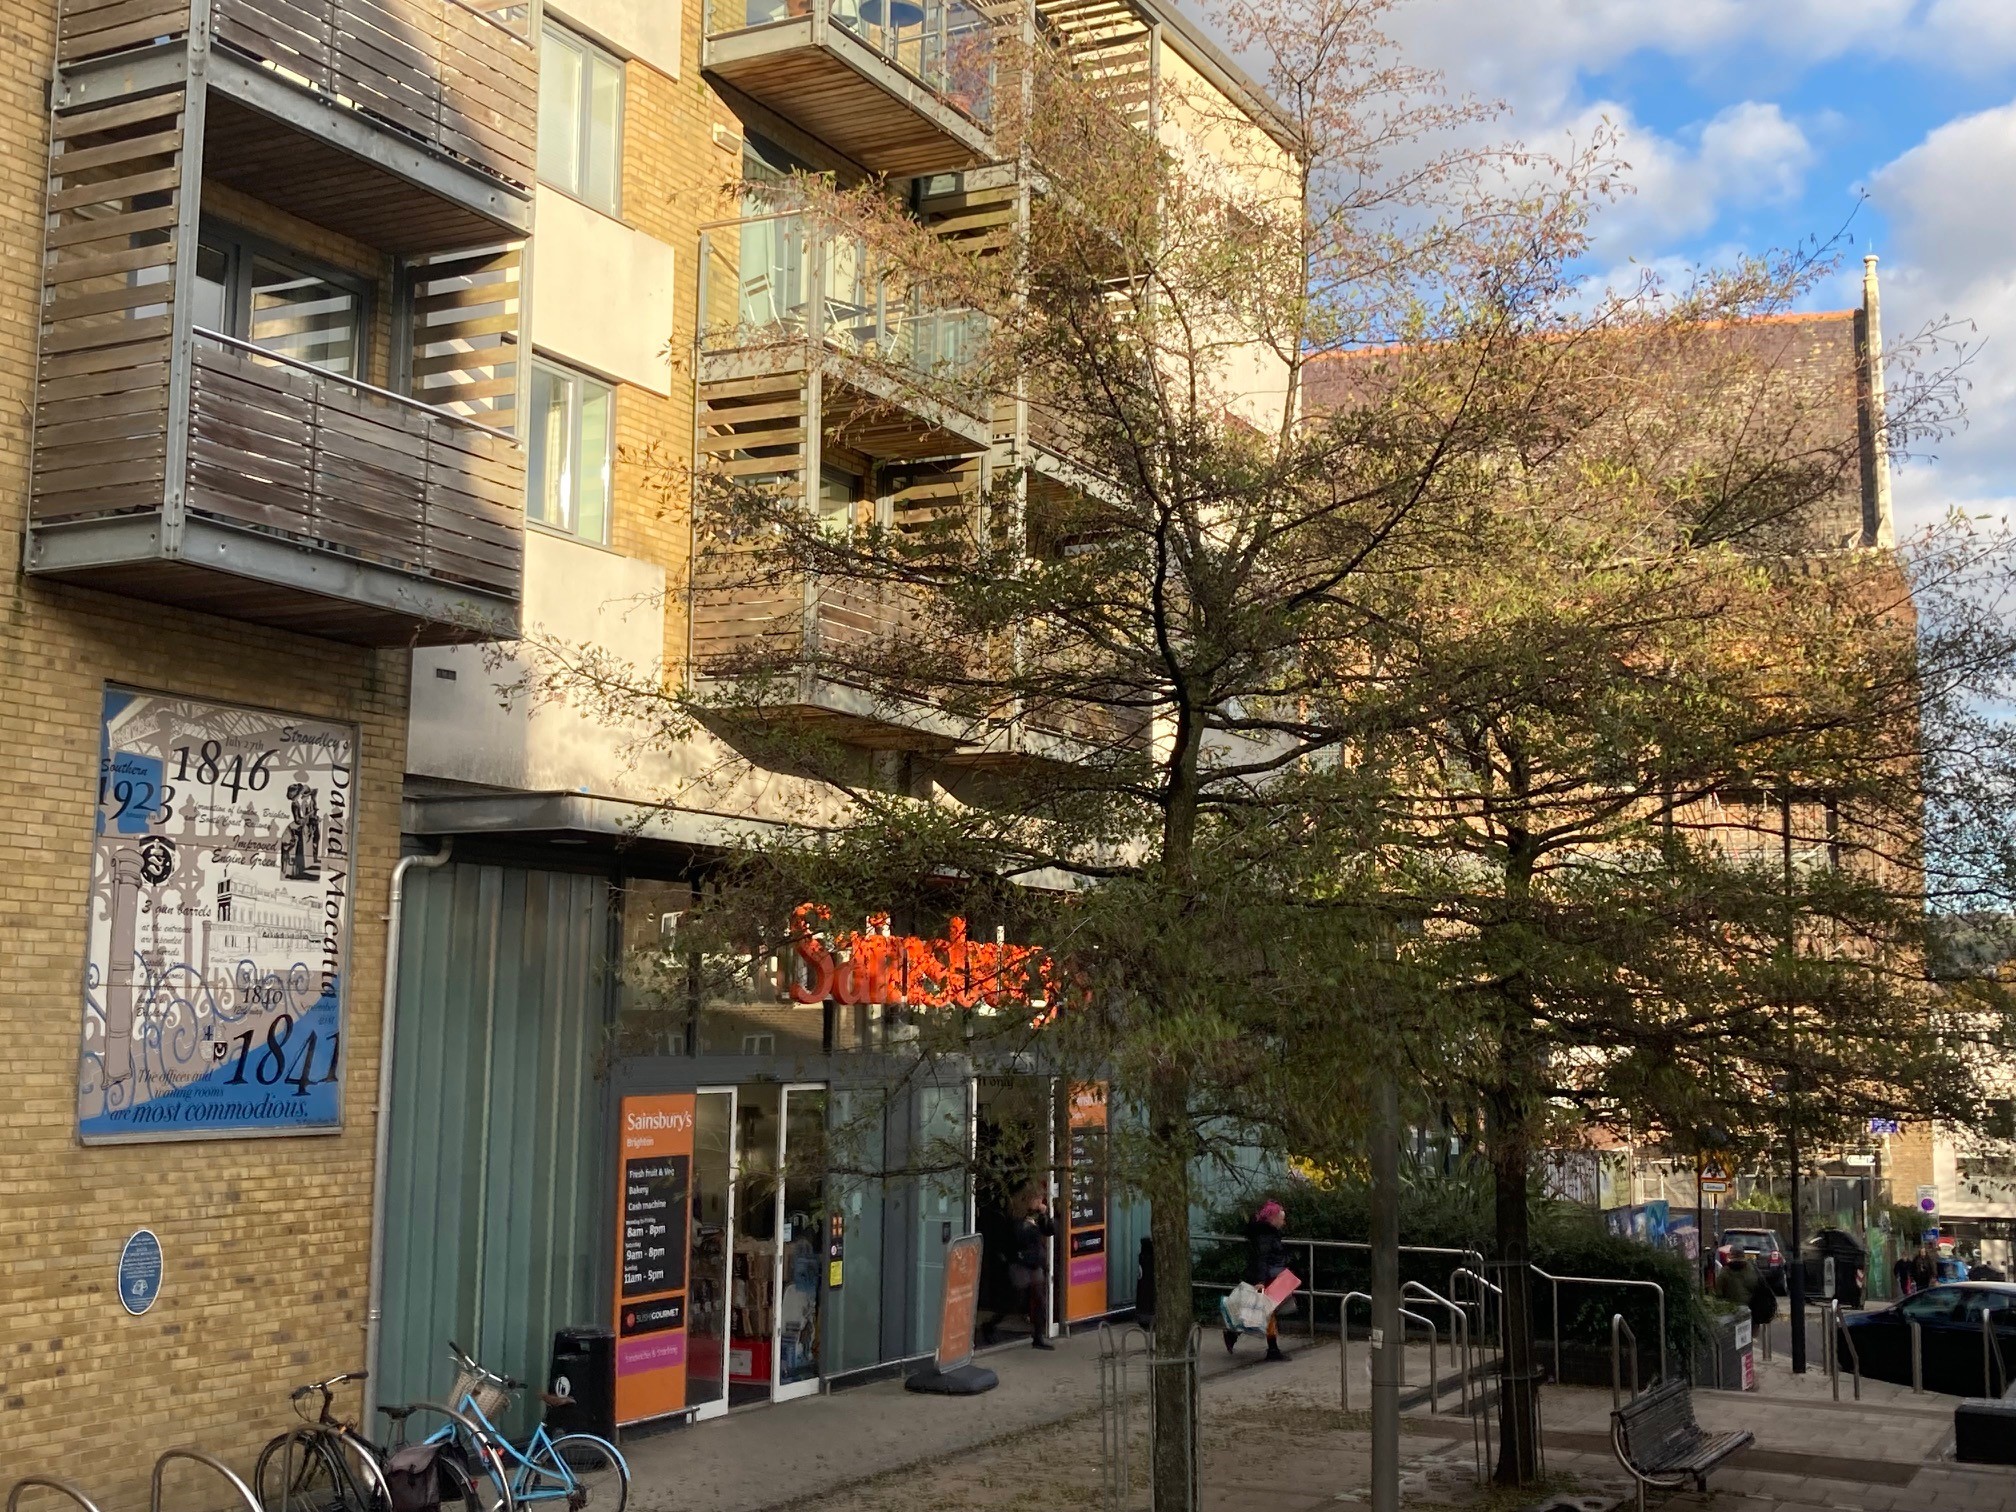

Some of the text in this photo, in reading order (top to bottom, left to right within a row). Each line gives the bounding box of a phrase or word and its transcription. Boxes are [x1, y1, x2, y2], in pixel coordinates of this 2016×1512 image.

[225, 736, 264, 750] July 27th
[280, 726, 349, 751] Stroudley's
[101, 759, 148, 776] Southern
[171, 740, 280, 804] 1846
[98, 777, 176, 825] 1923
[327, 764, 350, 857] David
[233, 834, 279, 852] Improved
[211, 848, 277, 870] Engine Green
[141, 899, 212, 920] 3 gun barrels
[320, 866, 347, 998] Mocatta
[243, 985, 283, 1011] 1840
[223, 1014, 340, 1097] 1841
[137, 1067, 214, 1089] The offices and
[154, 1087, 224, 1099] waiting rooms
[109, 1107, 131, 1122] are
[132, 1099, 181, 1124] most
[184, 1092, 309, 1122] commodious.
[627, 1111, 693, 1132] Sainsbury's
[626, 1136, 655, 1149] Brighton
[629, 1170, 645, 1179] Fresh
[659, 1168, 664, 1176] &
[628, 1185, 650, 1196] Bakery
[628, 1199, 667, 1211] Cash machine
[627, 1226, 644, 1238] 8am
[649, 1224, 666, 1238] 8pm
[626, 1250, 643, 1261] 9am
[648, 1247, 665, 1260] 8pm
[624, 1272, 643, 1284] 11am
[647, 1269, 664, 1282] 5pm
